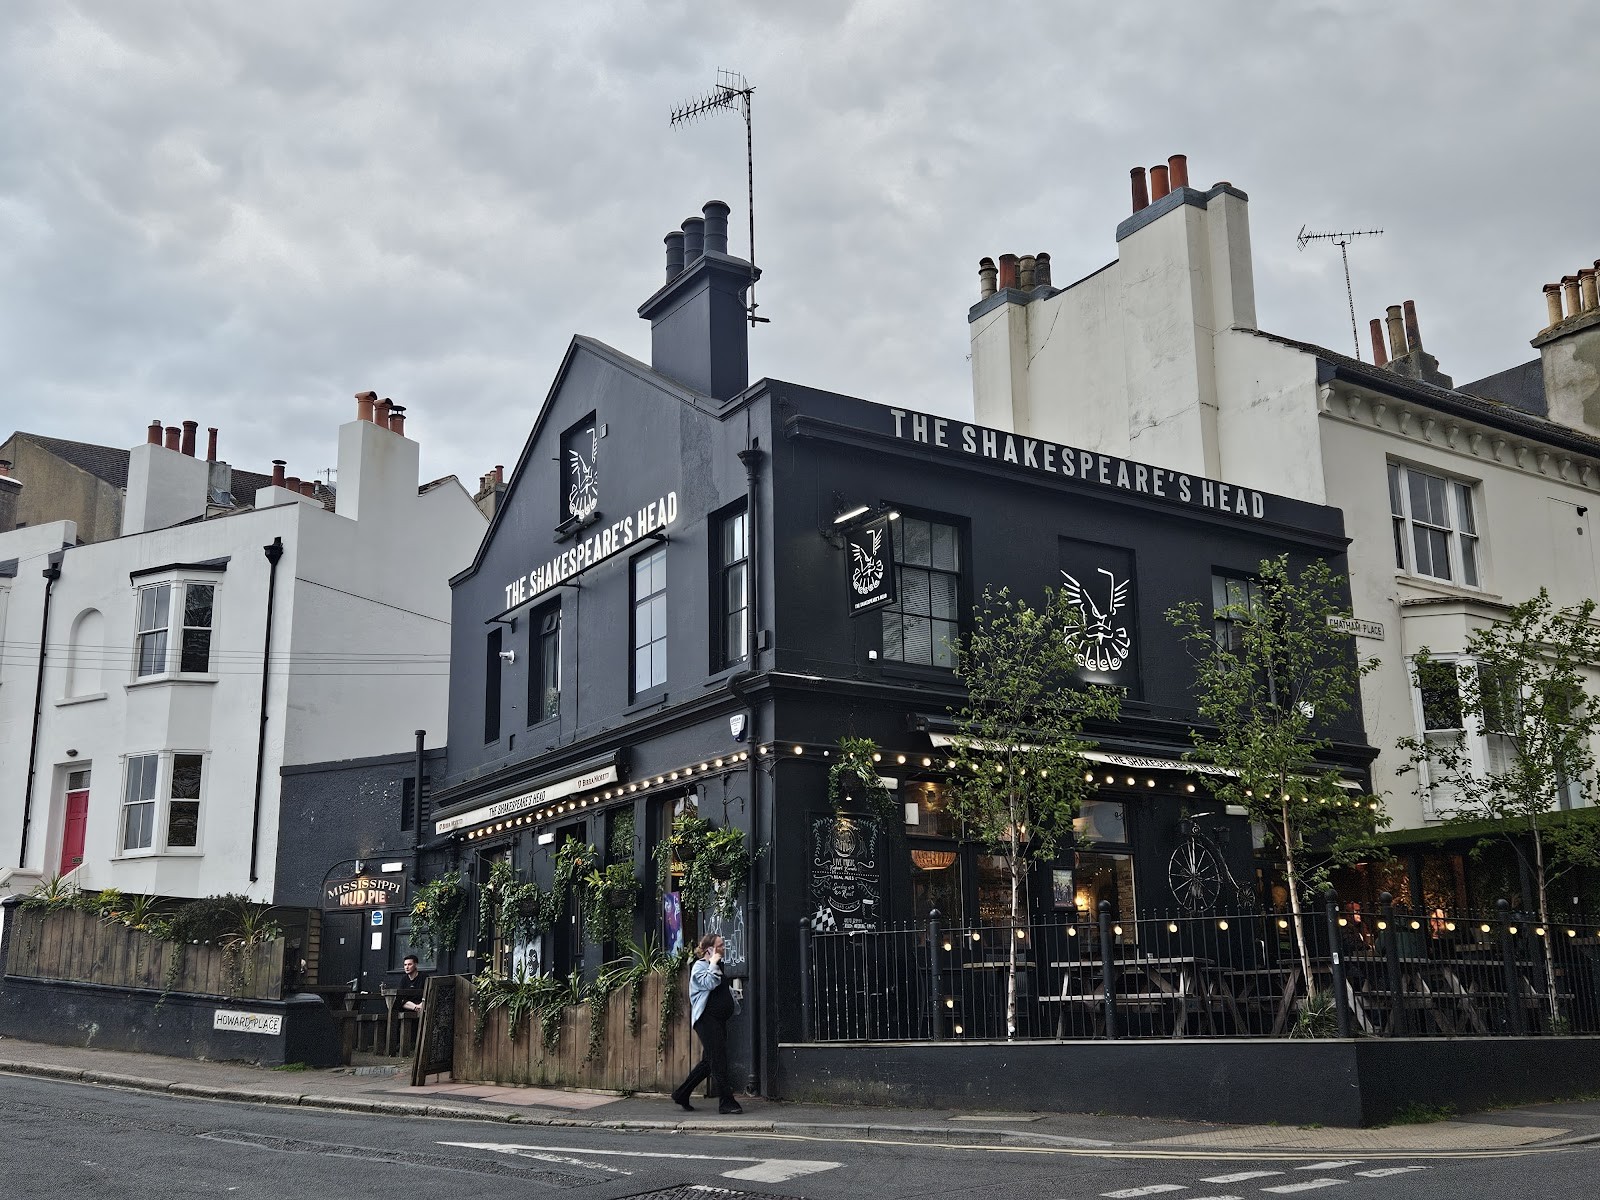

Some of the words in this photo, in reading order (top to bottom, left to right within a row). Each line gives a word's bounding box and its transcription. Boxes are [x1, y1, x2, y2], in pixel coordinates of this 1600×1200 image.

[891, 409, 948, 448] THE
[962, 425, 1191, 502] SHAKESPEARE'S
[1202, 480, 1264, 519] HEAD
[505, 576, 527, 609] THE
[529, 516, 633, 597] SHAKESPEARE'S
[637, 491, 677, 538] HEAD
[1363, 624, 1382, 636] PLACE
[1105, 754, 1127, 765] THE
[488, 806, 497, 817] THE
[533, 790, 546, 806] HEAD
[328, 879, 400, 899] MISSISSIPPI
[340, 890, 366, 906] MUD
[367, 889, 386, 905] PIE
[216, 1014, 250, 1027] HOWARD
[253, 1018, 279, 1030] PLACE
